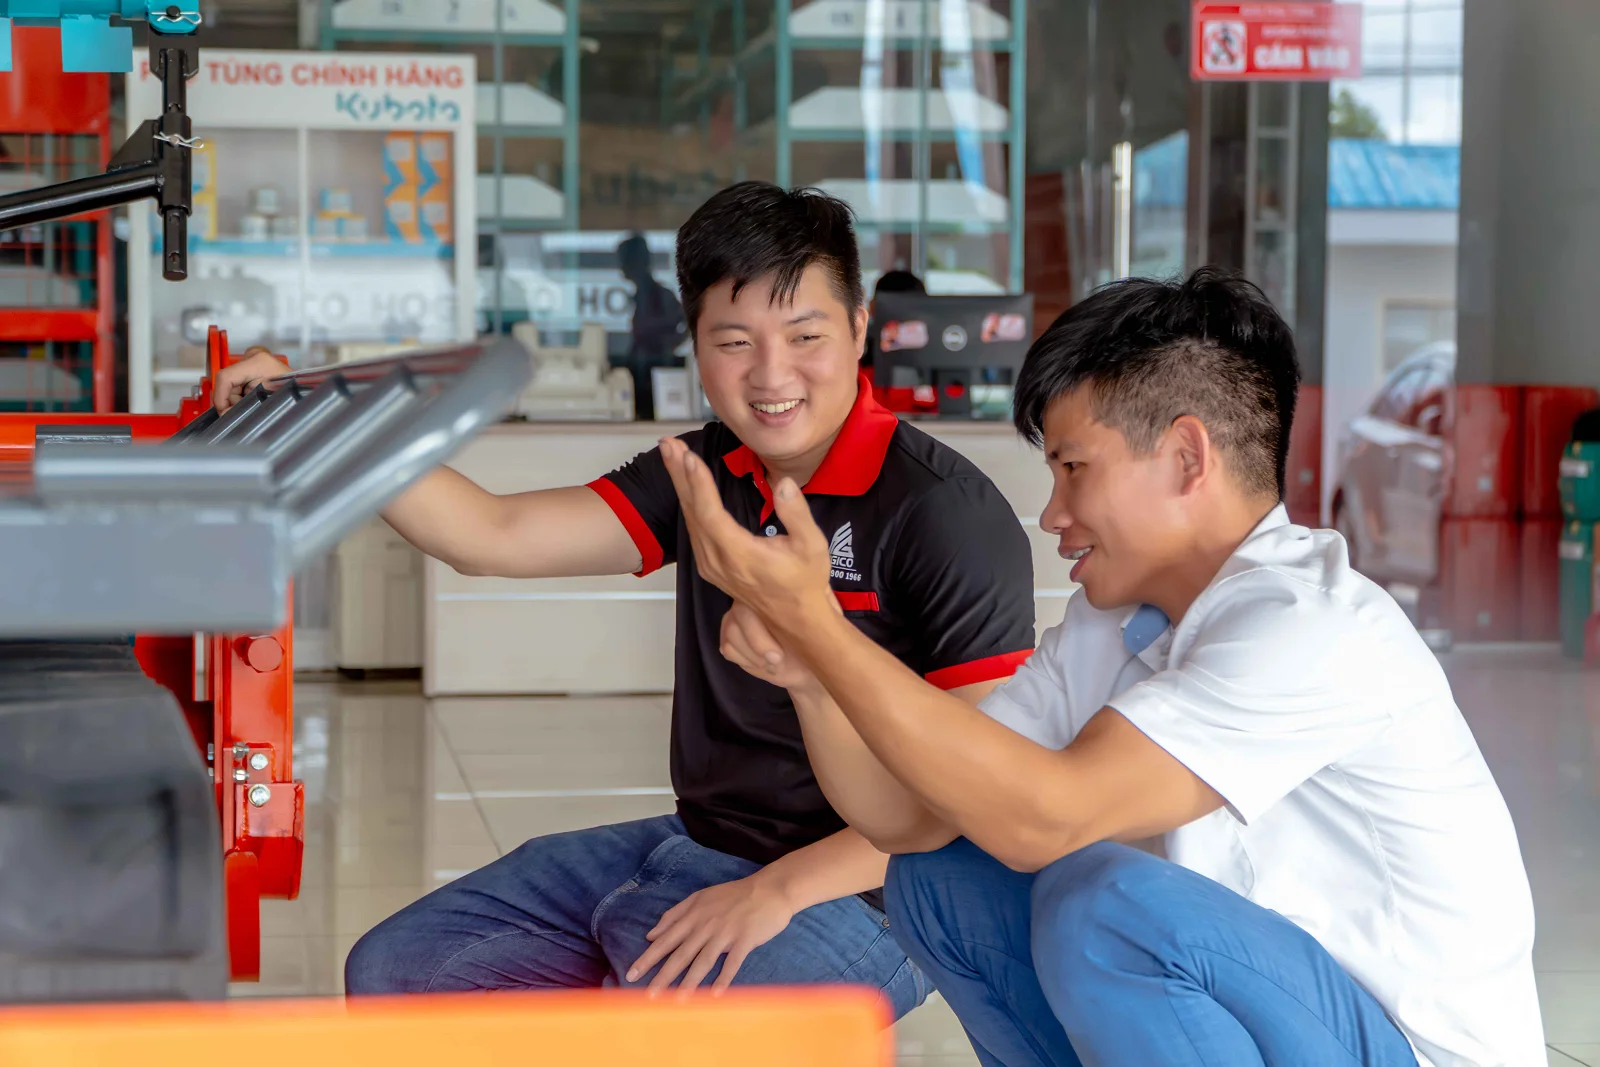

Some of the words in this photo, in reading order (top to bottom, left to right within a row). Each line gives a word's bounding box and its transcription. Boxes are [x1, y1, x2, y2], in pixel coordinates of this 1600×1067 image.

[205, 58, 283, 85] TÙNG
[291, 58, 377, 87] CHÍNH
[845, 572, 861, 581] 1966
